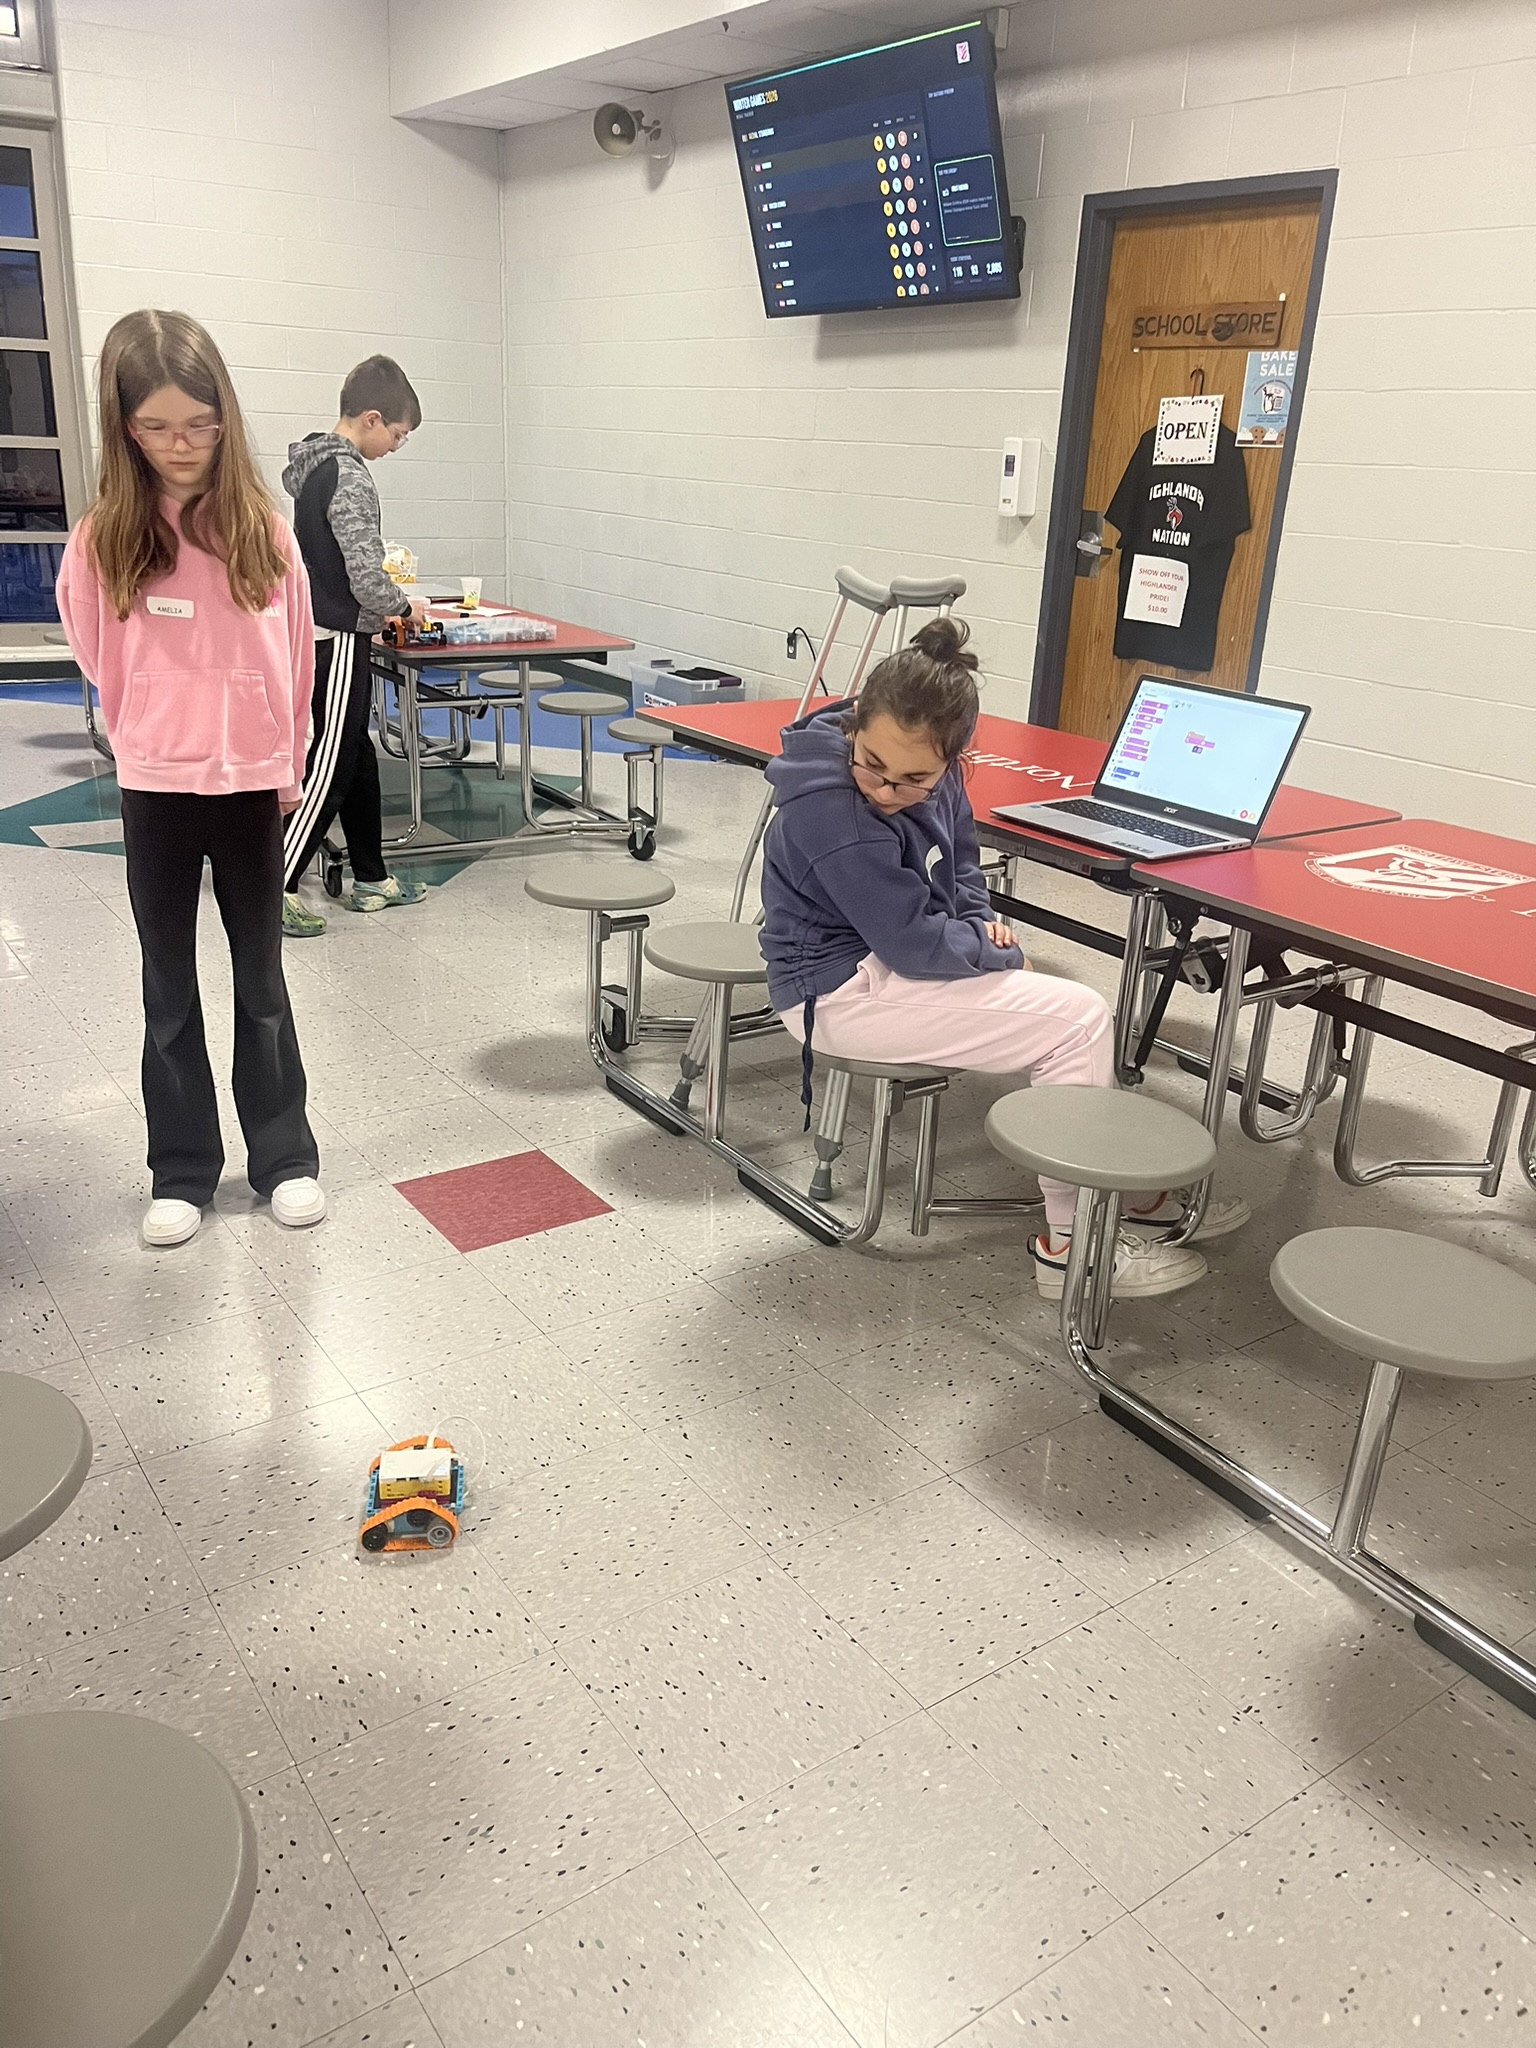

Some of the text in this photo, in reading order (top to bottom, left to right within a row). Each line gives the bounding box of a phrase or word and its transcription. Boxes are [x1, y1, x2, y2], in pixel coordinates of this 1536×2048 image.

[1132, 312, 1277, 337] SCHOOL STORE
[1261, 351, 1297, 362] BAKE
[1260, 363, 1294, 377] SALE
[1164, 422, 1208, 440] OPEN
[1152, 529, 1190, 547] NATION
[1139, 568, 1159, 577] SHOW
[1140, 580, 1178, 592] HIGHLANDER
[157, 606, 182, 614] AMELIA
[1148, 604, 1168, 614] $10.00
[1163, 806, 1178, 814] acer
